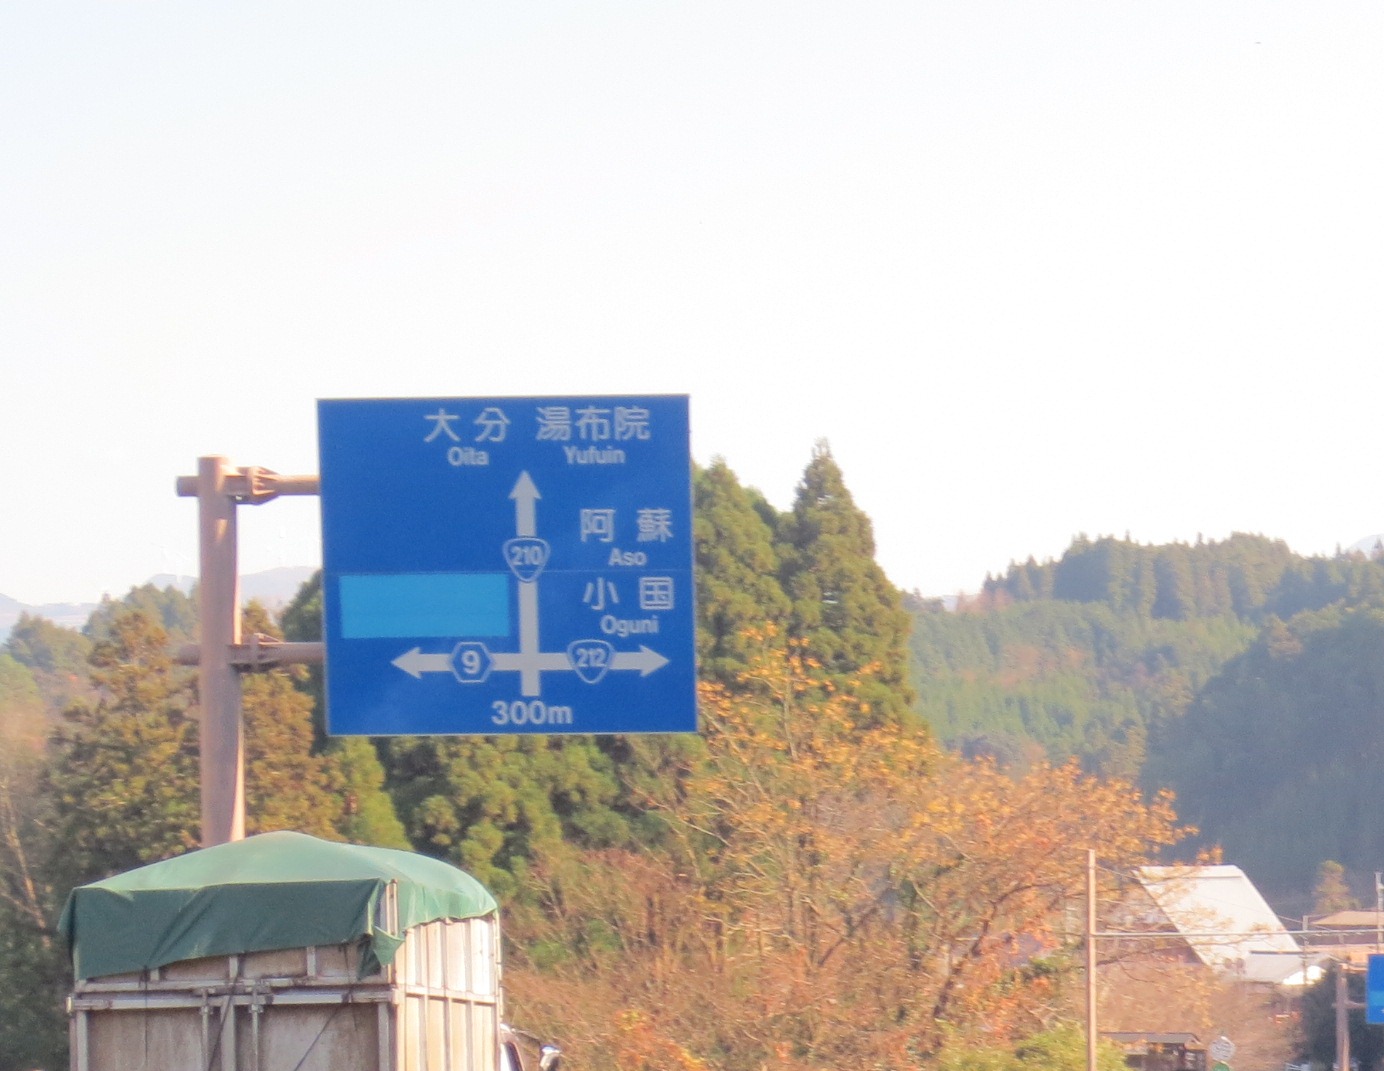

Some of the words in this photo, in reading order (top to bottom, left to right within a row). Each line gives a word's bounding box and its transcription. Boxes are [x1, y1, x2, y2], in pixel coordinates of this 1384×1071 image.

[423, 407, 512, 443] 大分
[535, 404, 652, 442] 湯布院
[447, 446, 490, 467] Oita
[563, 445, 627, 465] Yufuin
[579, 508, 674, 543] 阿蘇
[510, 546, 545, 566] 210
[608, 548, 648, 567] Aso
[582, 576, 675, 611] 小国
[600, 614, 660, 638] Oguni
[460, 649, 481, 675] 9
[575, 648, 607, 668] 212
[491, 701, 574, 726] 300m
